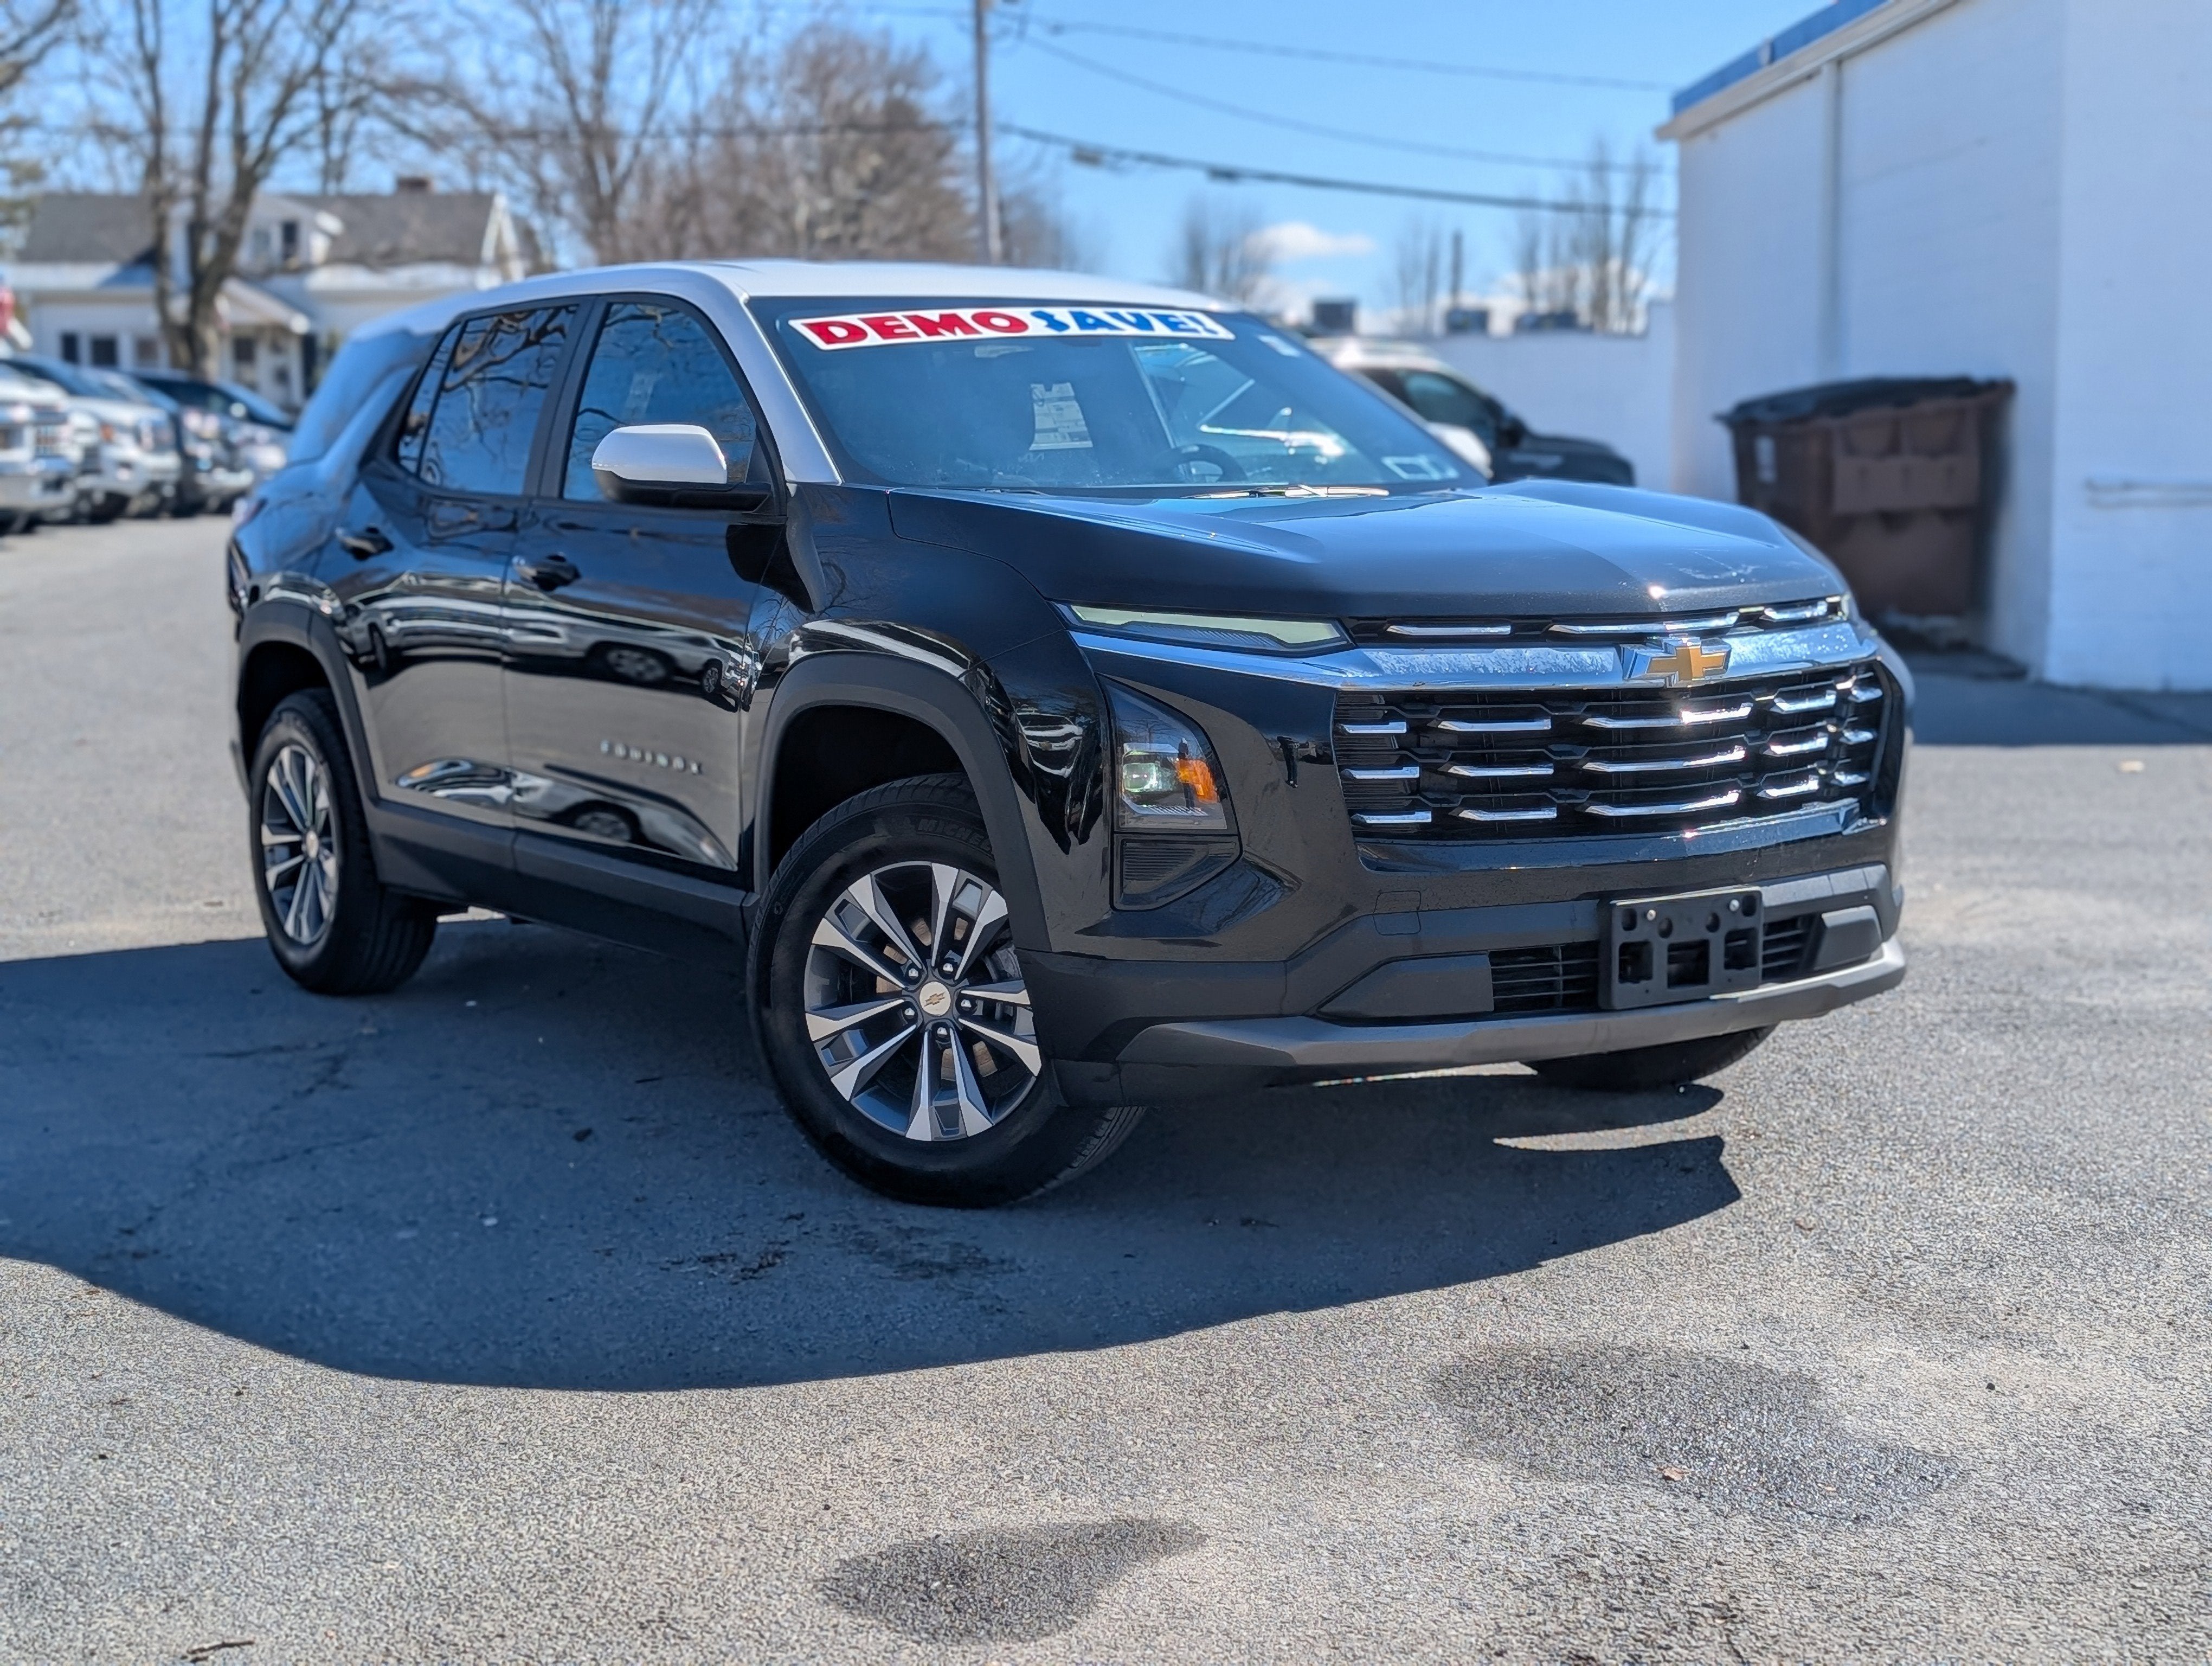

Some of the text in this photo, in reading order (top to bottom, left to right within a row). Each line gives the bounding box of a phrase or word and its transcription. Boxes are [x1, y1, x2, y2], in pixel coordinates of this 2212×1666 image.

[802, 310, 1219, 345] DEMO SAVE!
[917, 819, 992, 851] MICHEL
